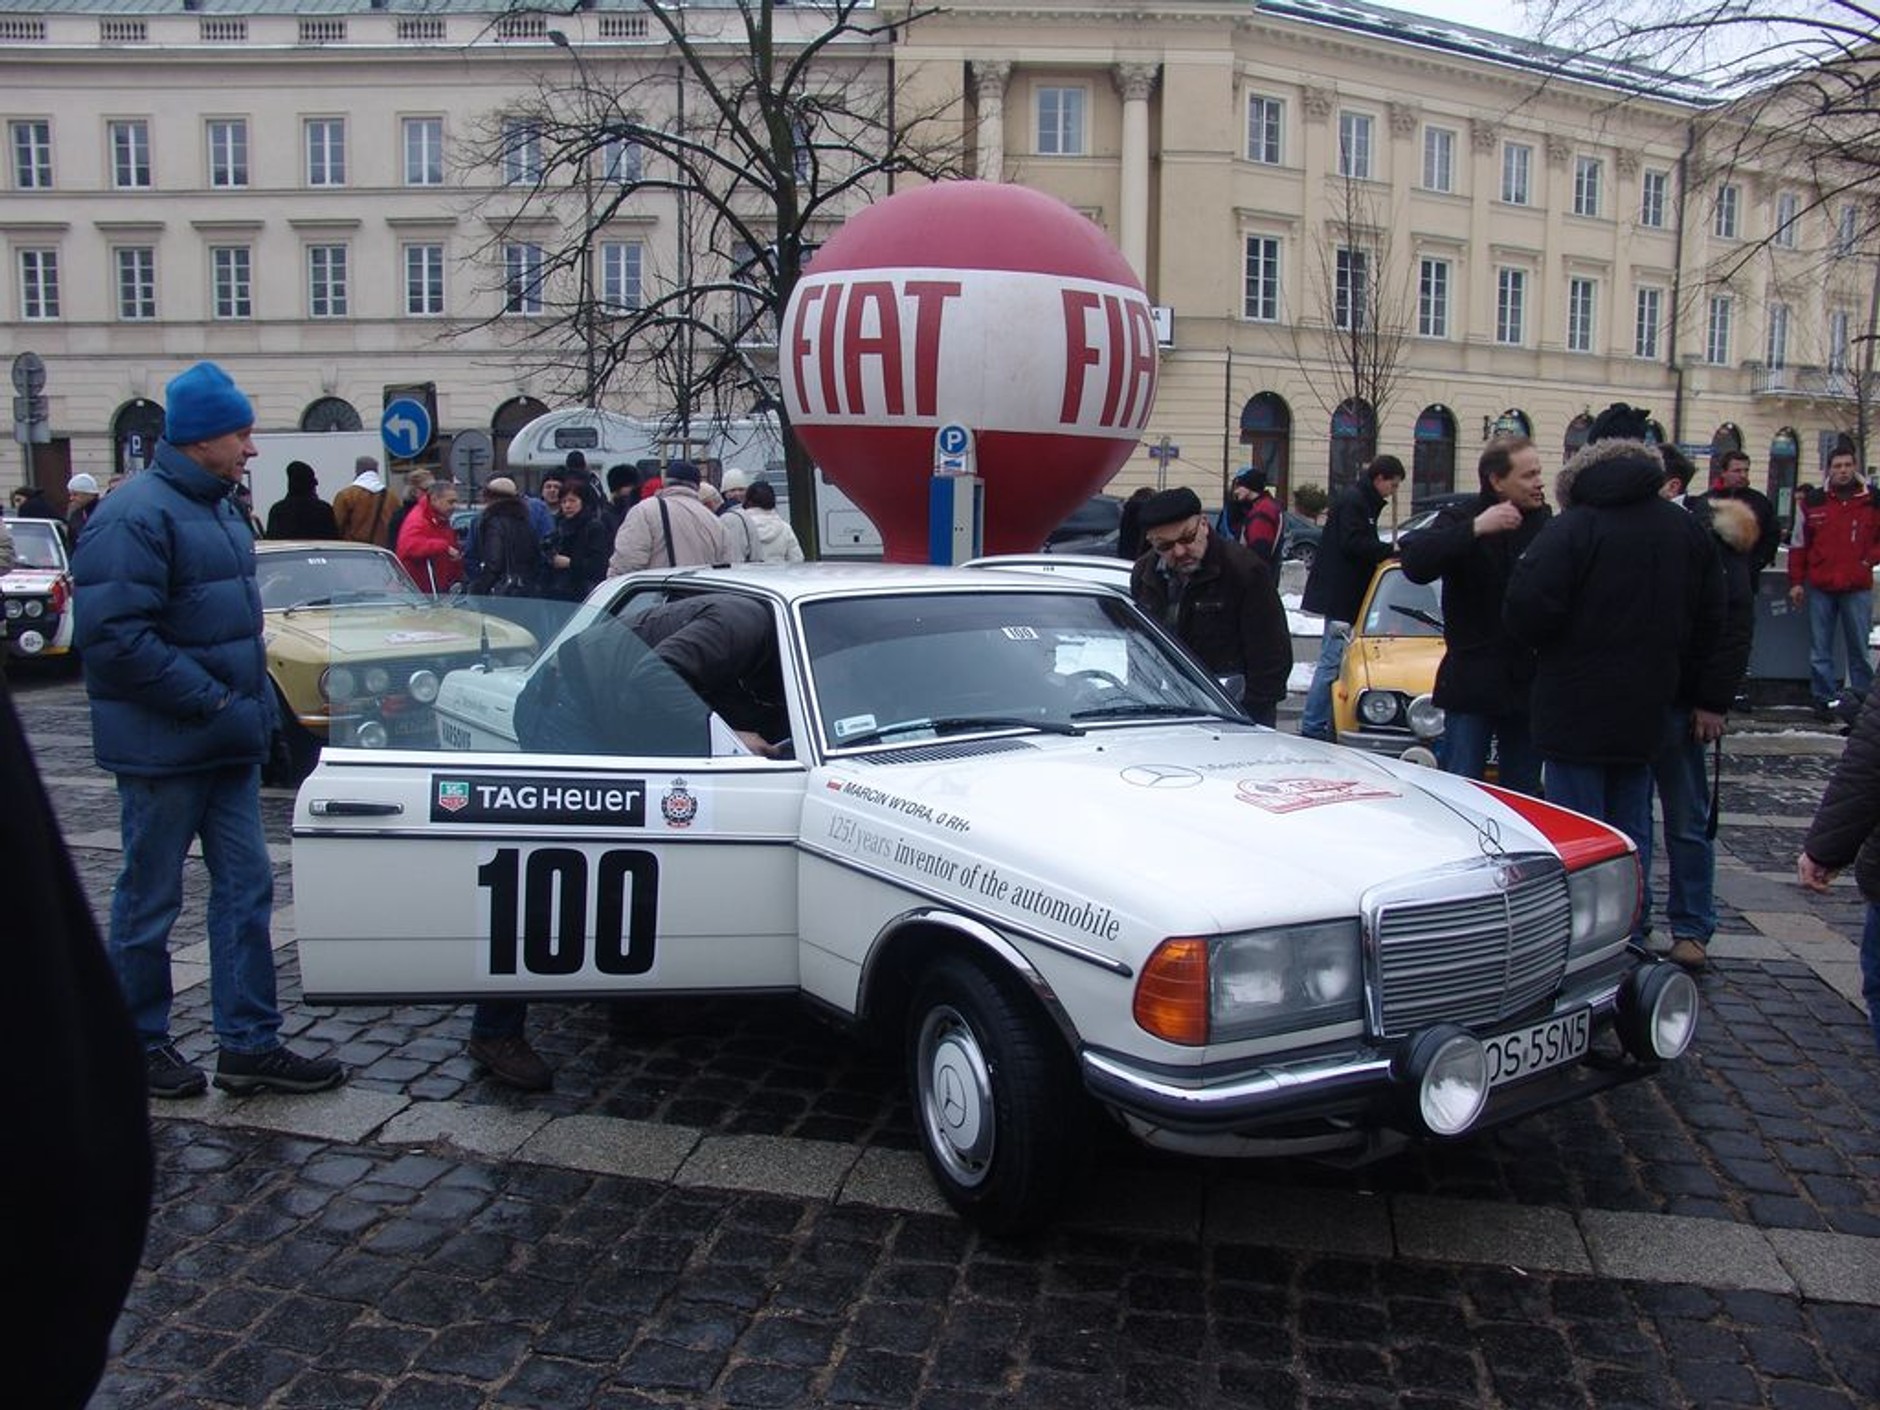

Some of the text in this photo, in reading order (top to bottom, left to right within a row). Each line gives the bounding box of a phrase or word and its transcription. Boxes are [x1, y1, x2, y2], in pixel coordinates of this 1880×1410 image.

[793, 281, 962, 416] FIAT
[1060, 288, 1160, 429] FIA
[947, 431, 963, 451] P
[843, 782, 890, 806] MARCIN
[888, 796, 934, 824] WYDRA,
[478, 848, 660, 975] 100
[827, 814, 1120, 941] 125! years inventor of the automobile
[1529, 1012, 1588, 1069] 5SN5
